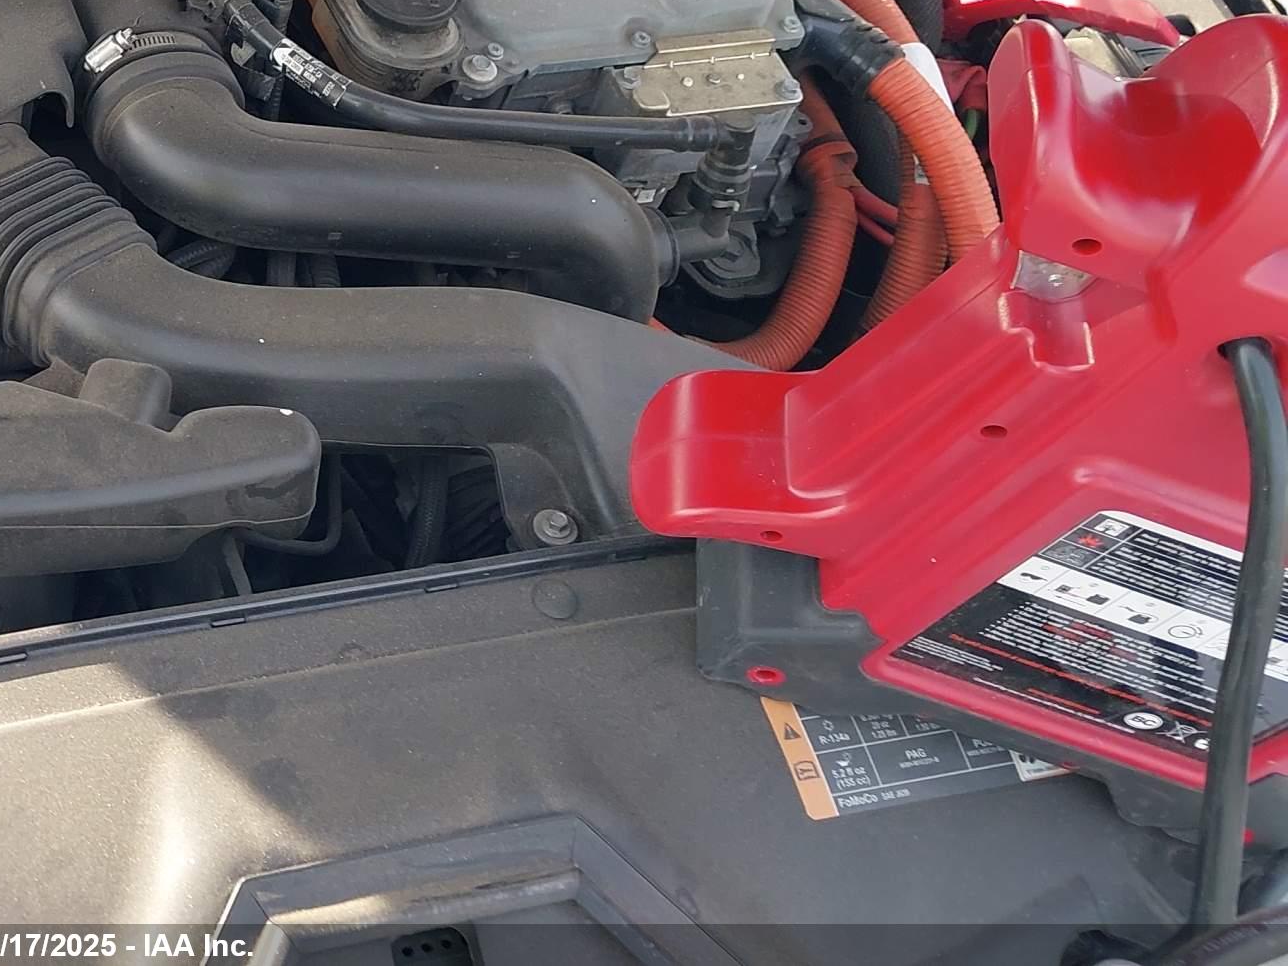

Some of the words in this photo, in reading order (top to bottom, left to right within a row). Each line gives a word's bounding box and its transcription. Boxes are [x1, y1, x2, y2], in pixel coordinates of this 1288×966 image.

[818, 732, 850, 745] R-134a
[905, 748, 927, 760] PAG
[837, 793, 878, 808] FoMoCo
